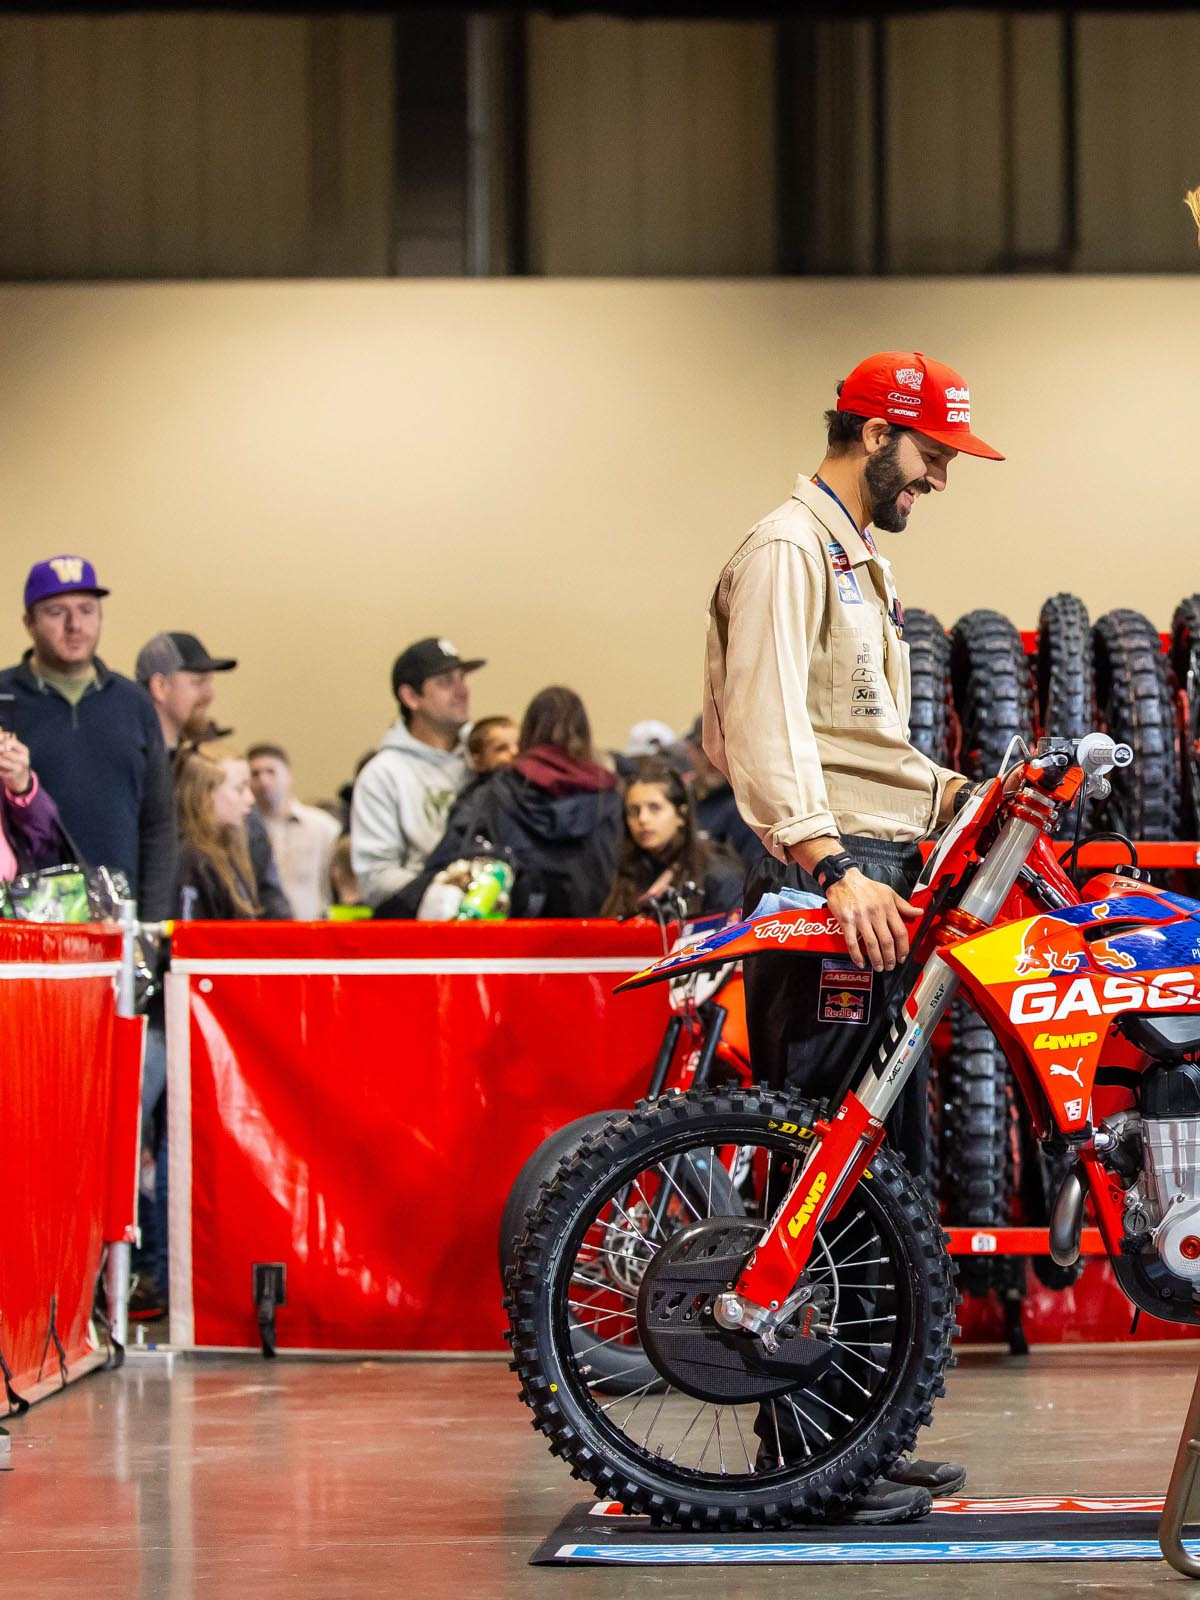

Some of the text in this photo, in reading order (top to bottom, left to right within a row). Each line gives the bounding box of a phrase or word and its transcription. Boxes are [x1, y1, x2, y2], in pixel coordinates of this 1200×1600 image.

[49, 558, 84, 584] W
[755, 920, 792, 944] Troy
[791, 918, 825, 937] Lee
[824, 973, 871, 983] GASGAS
[929, 983, 945, 1009] SKF
[824, 1006, 864, 1020] Red Bull
